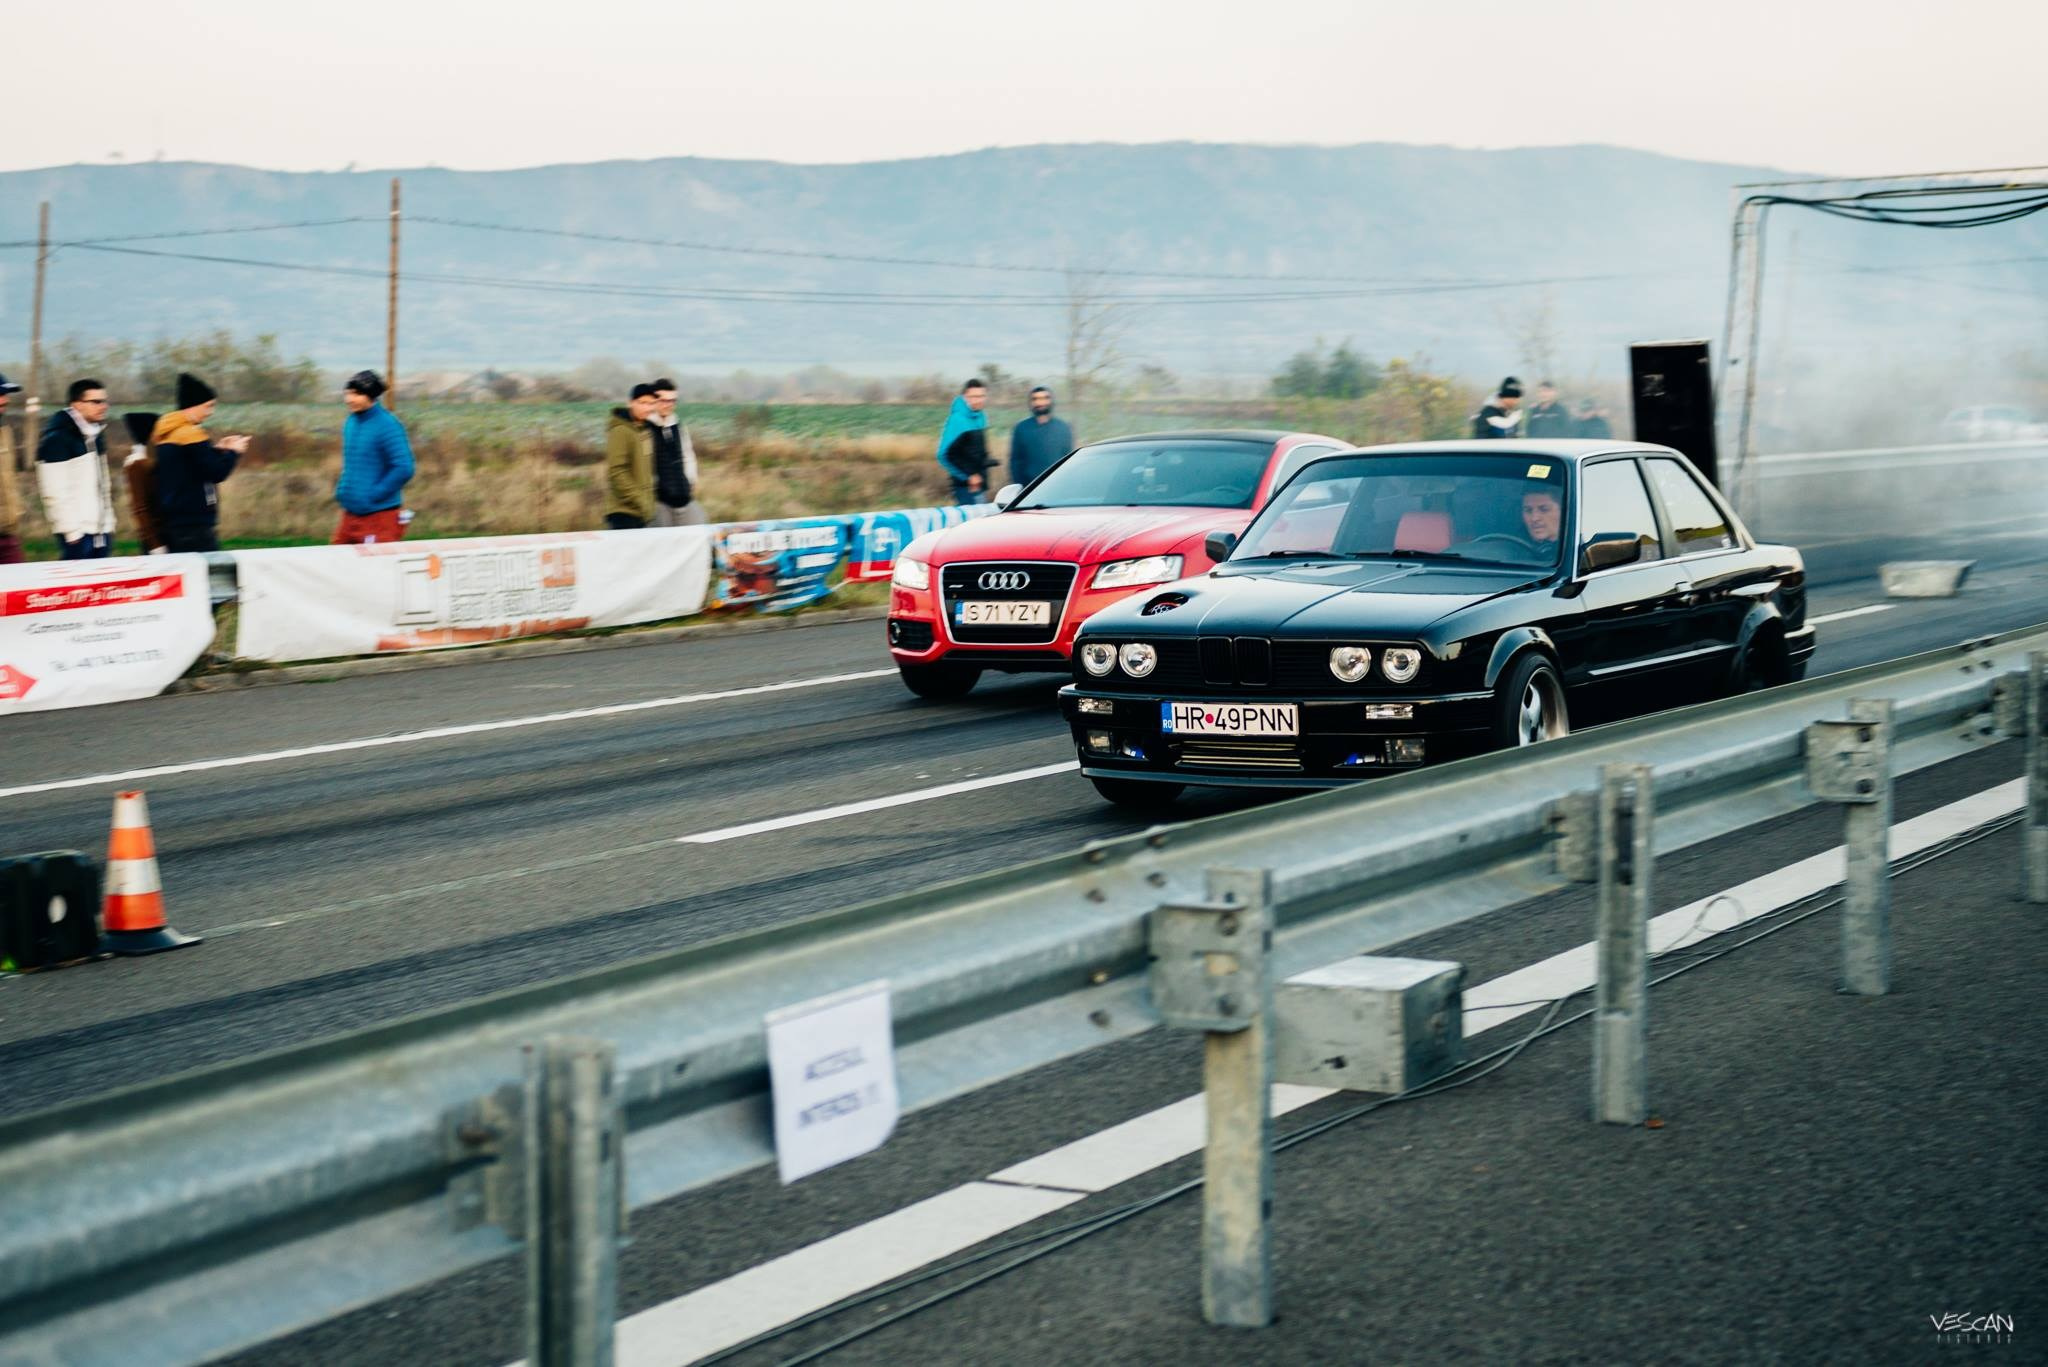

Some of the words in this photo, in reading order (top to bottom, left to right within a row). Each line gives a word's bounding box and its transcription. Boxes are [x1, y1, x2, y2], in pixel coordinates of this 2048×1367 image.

[985, 604, 1000, 621] 71
[1007, 604, 1041, 621] YZY
[1162, 719, 1173, 729] RO
